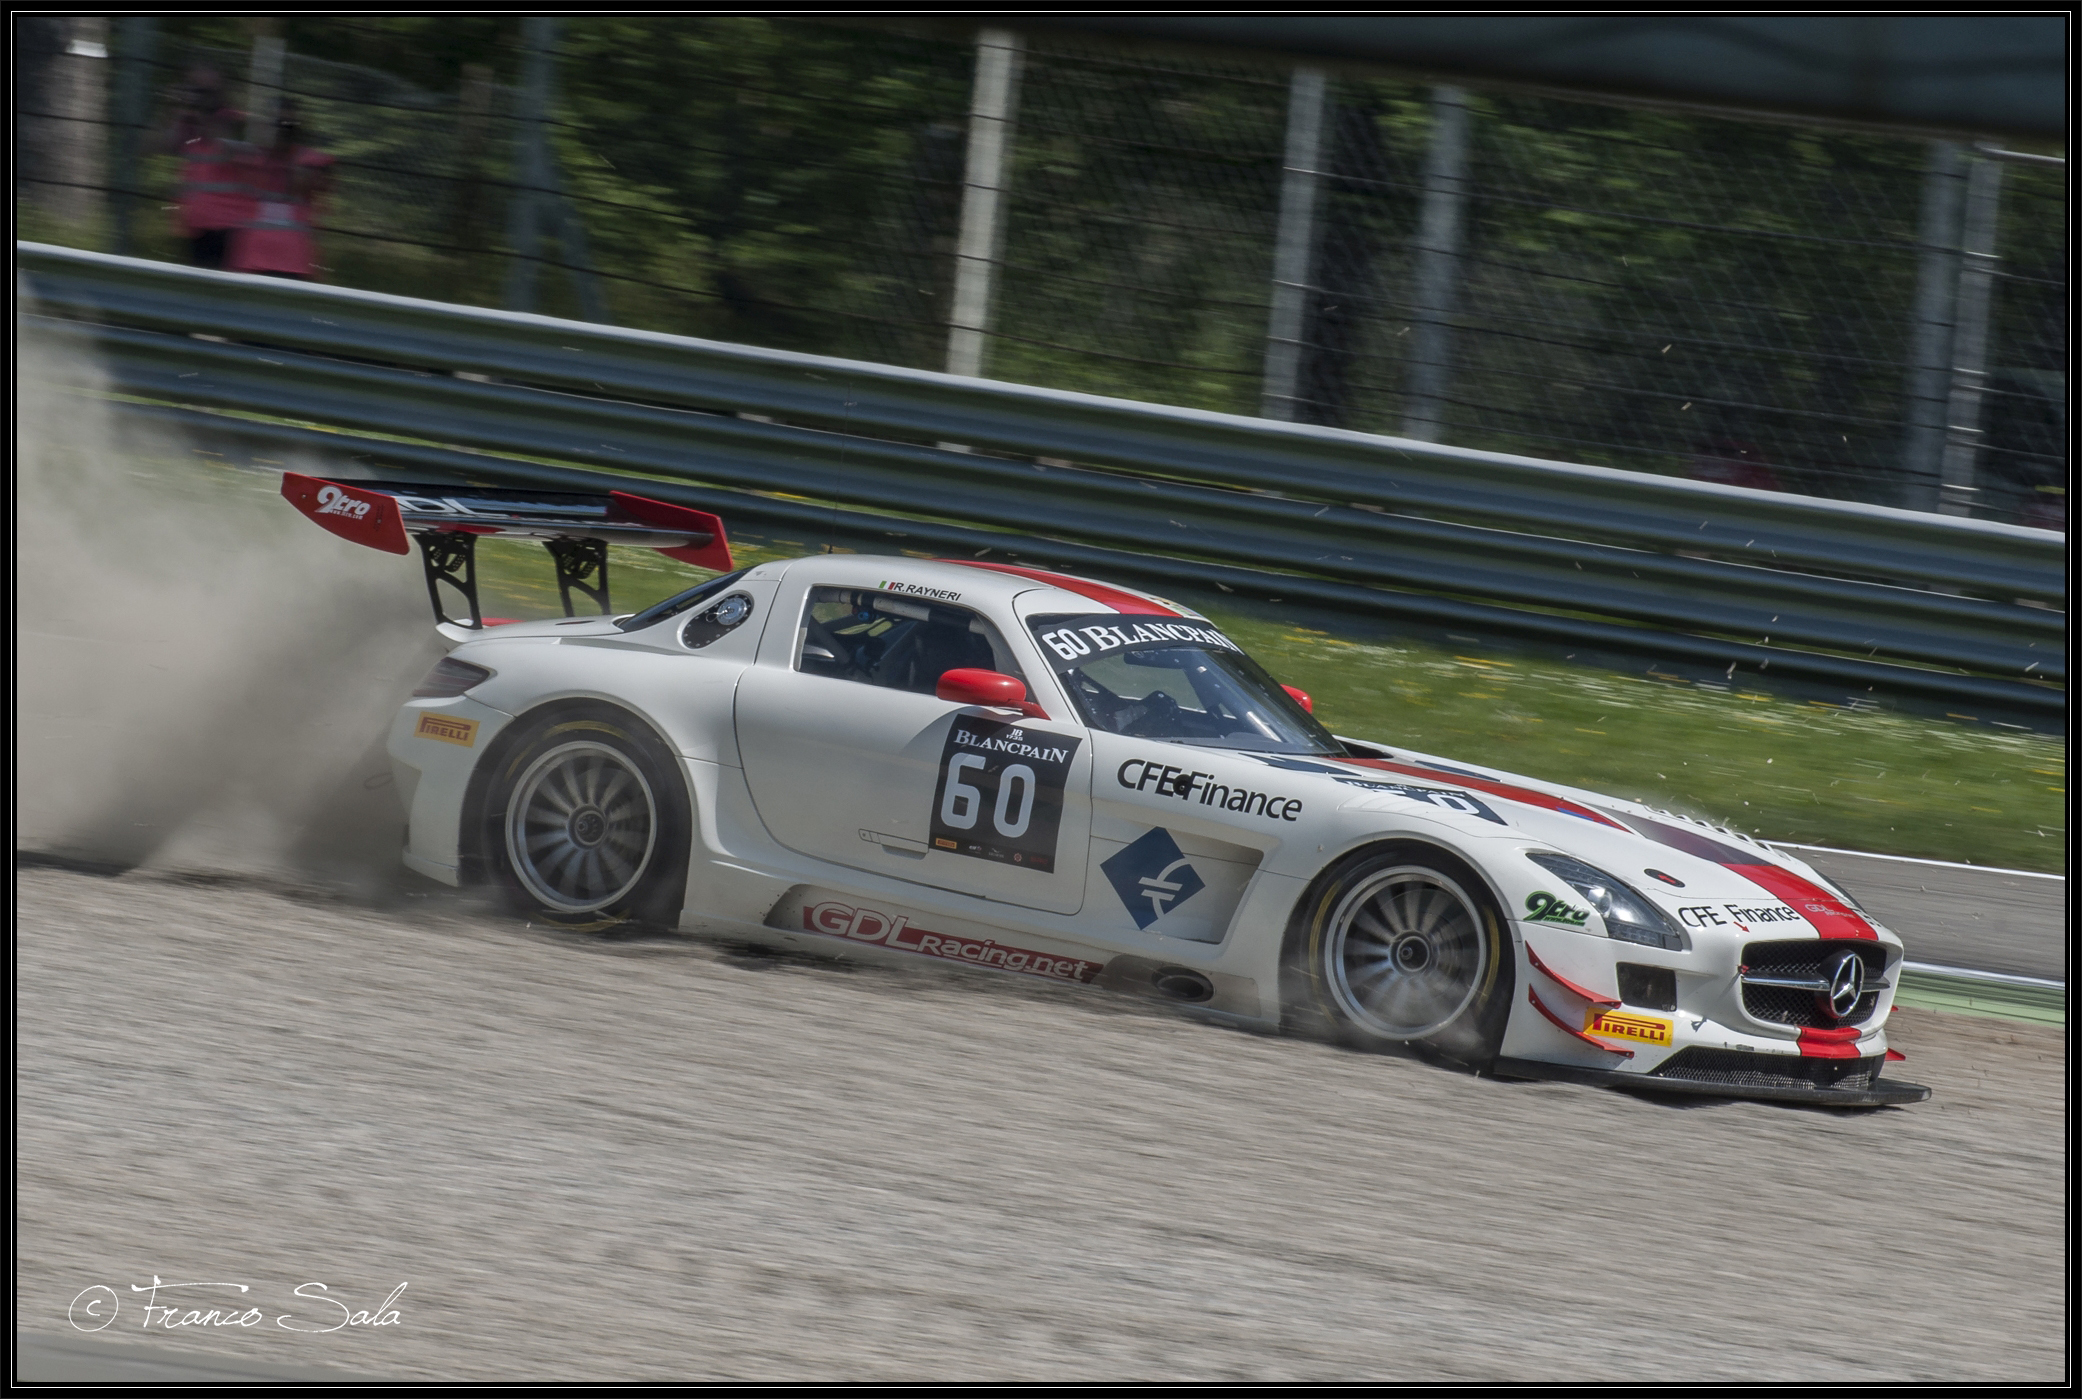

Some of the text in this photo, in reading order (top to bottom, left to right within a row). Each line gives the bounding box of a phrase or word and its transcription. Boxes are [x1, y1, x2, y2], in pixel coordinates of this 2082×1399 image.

[893, 582, 962, 602] R.RAYNERI
[1042, 623, 1246, 661] 60 BLANCPAIN
[419, 717, 471, 741] PIRELLI
[953, 729, 1069, 764] BLANCPAIN
[940, 752, 1036, 838] 60
[1181, 770, 1303, 822] Finance
[1678, 905, 1728, 928] CFE
[1723, 903, 1801, 924] Finance
[1592, 1013, 1666, 1041] PIRELLI
